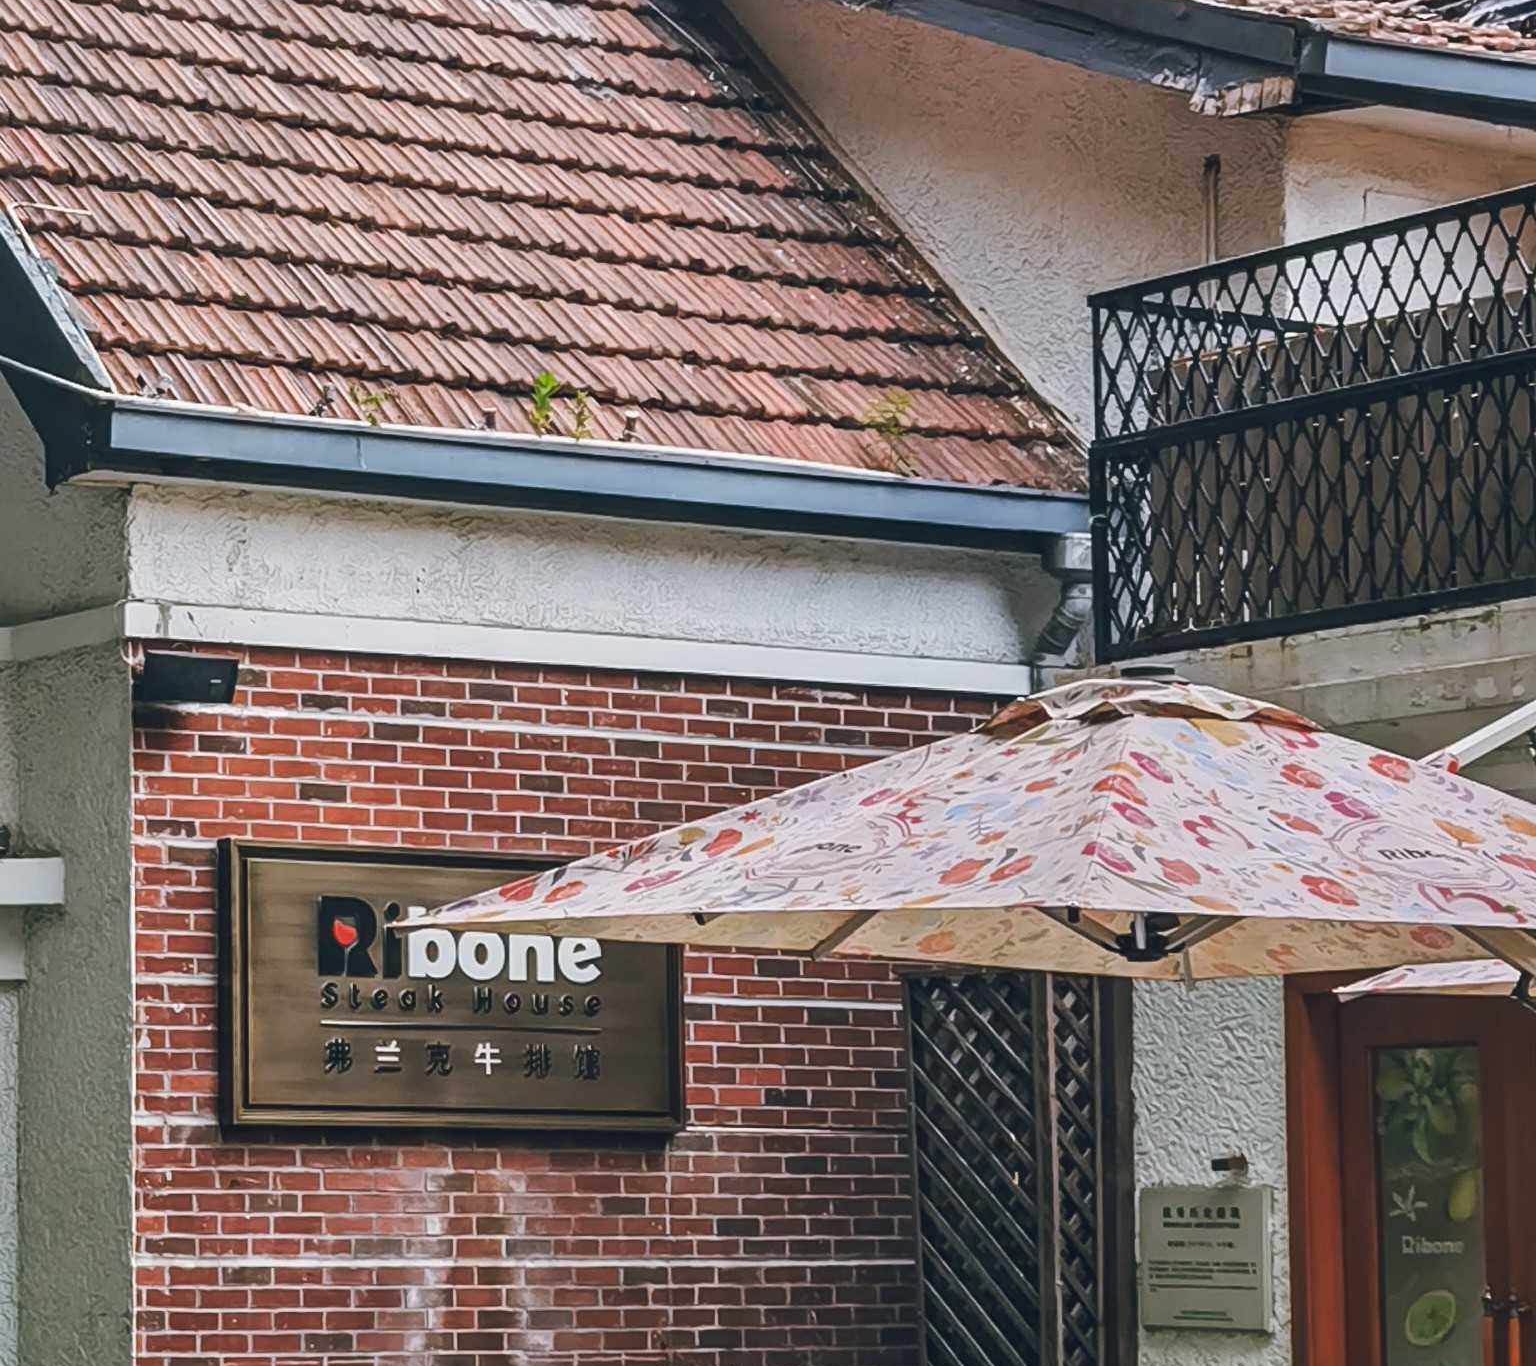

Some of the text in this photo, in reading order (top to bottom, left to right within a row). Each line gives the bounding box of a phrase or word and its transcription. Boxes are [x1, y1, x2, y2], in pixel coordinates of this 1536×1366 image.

[319, 981, 602, 1017] Steak House
[323, 1036, 602, 1081] 弗兰克牛排馆
